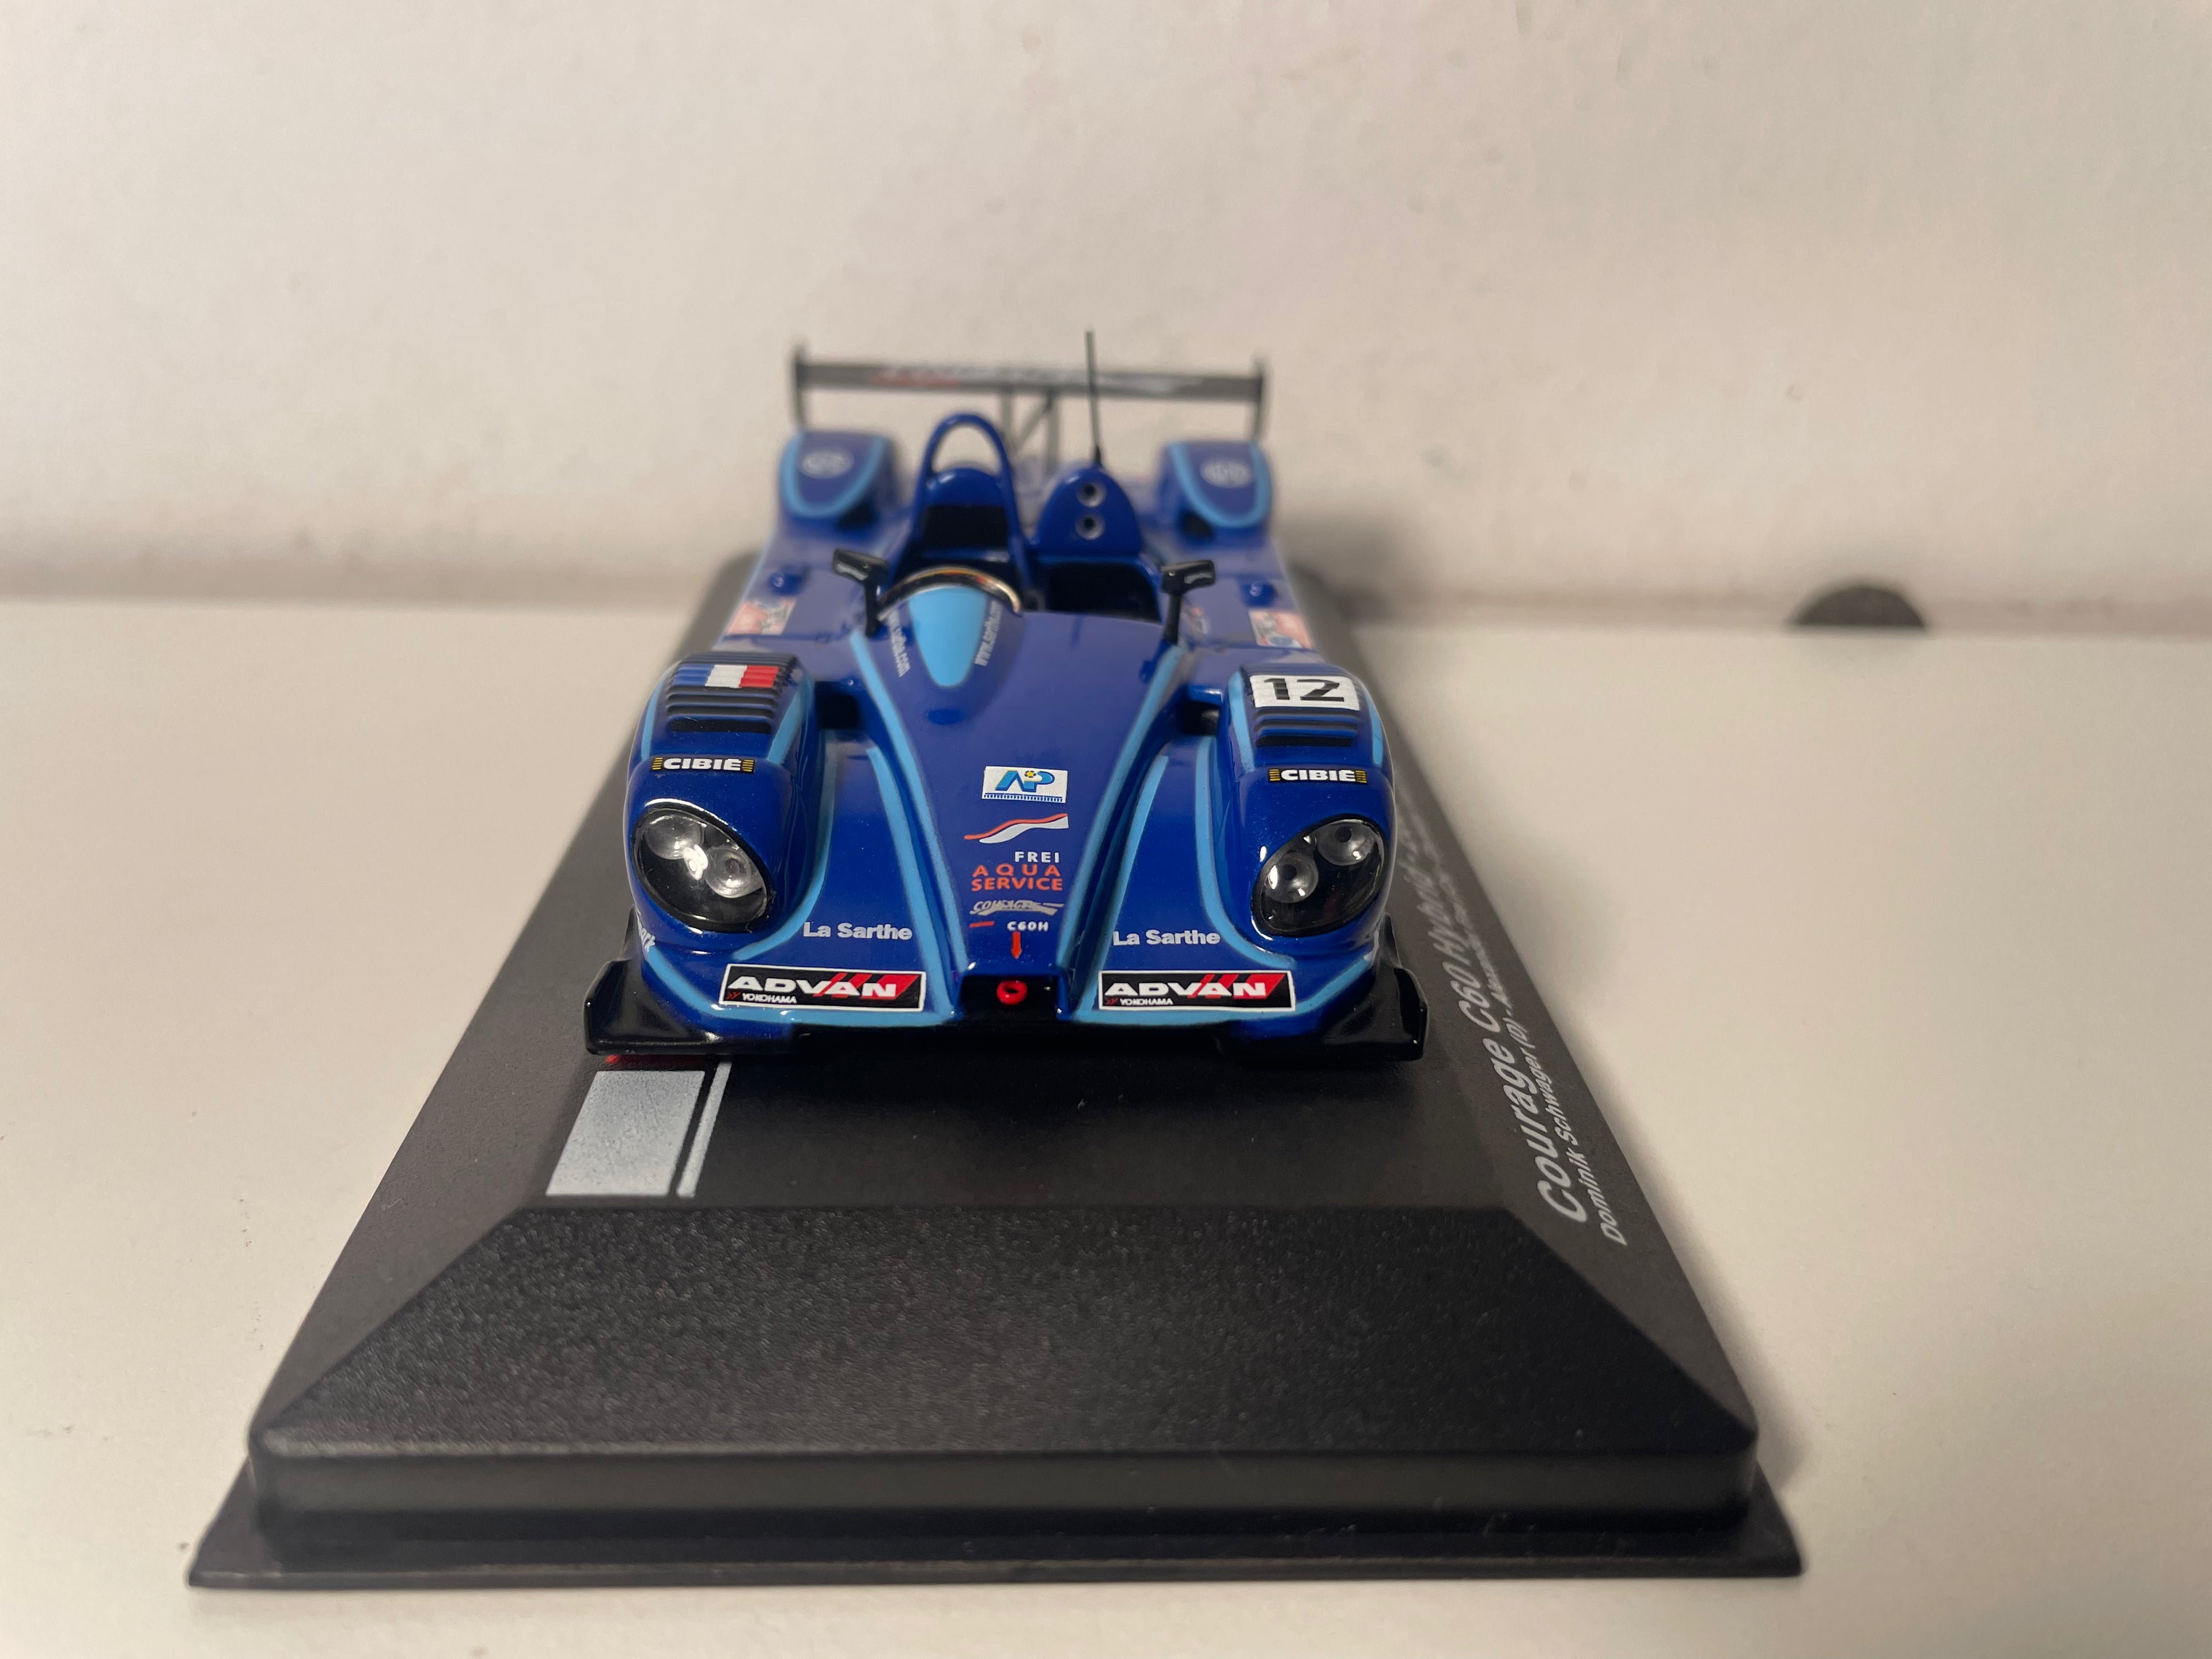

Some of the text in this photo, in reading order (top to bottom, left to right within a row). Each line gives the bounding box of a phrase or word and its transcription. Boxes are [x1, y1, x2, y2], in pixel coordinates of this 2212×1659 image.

[1264, 677, 1344, 702] 12
[1014, 851, 1060, 863] FREI
[972, 864, 1061, 878] AQUA
[971, 877, 1063, 892] SERVICE
[802, 922, 913, 940] La Sarthe
[1007, 921, 1050, 932] C60H
[1112, 929, 1221, 946] La Sarthe
[728, 976, 897, 997] ADVAN
[1104, 982, 1266, 997] ADVAN
[742, 993, 797, 1004] YOKOHAMA
[1119, 998, 1174, 1006] YOKOHAMA
[1442, 961, 1501, 1033] C60
[1520, 1047, 1578, 1146] Schwager
[1482, 1037, 1588, 1222] Courage
[1566, 1147, 1627, 1246] Dominik
